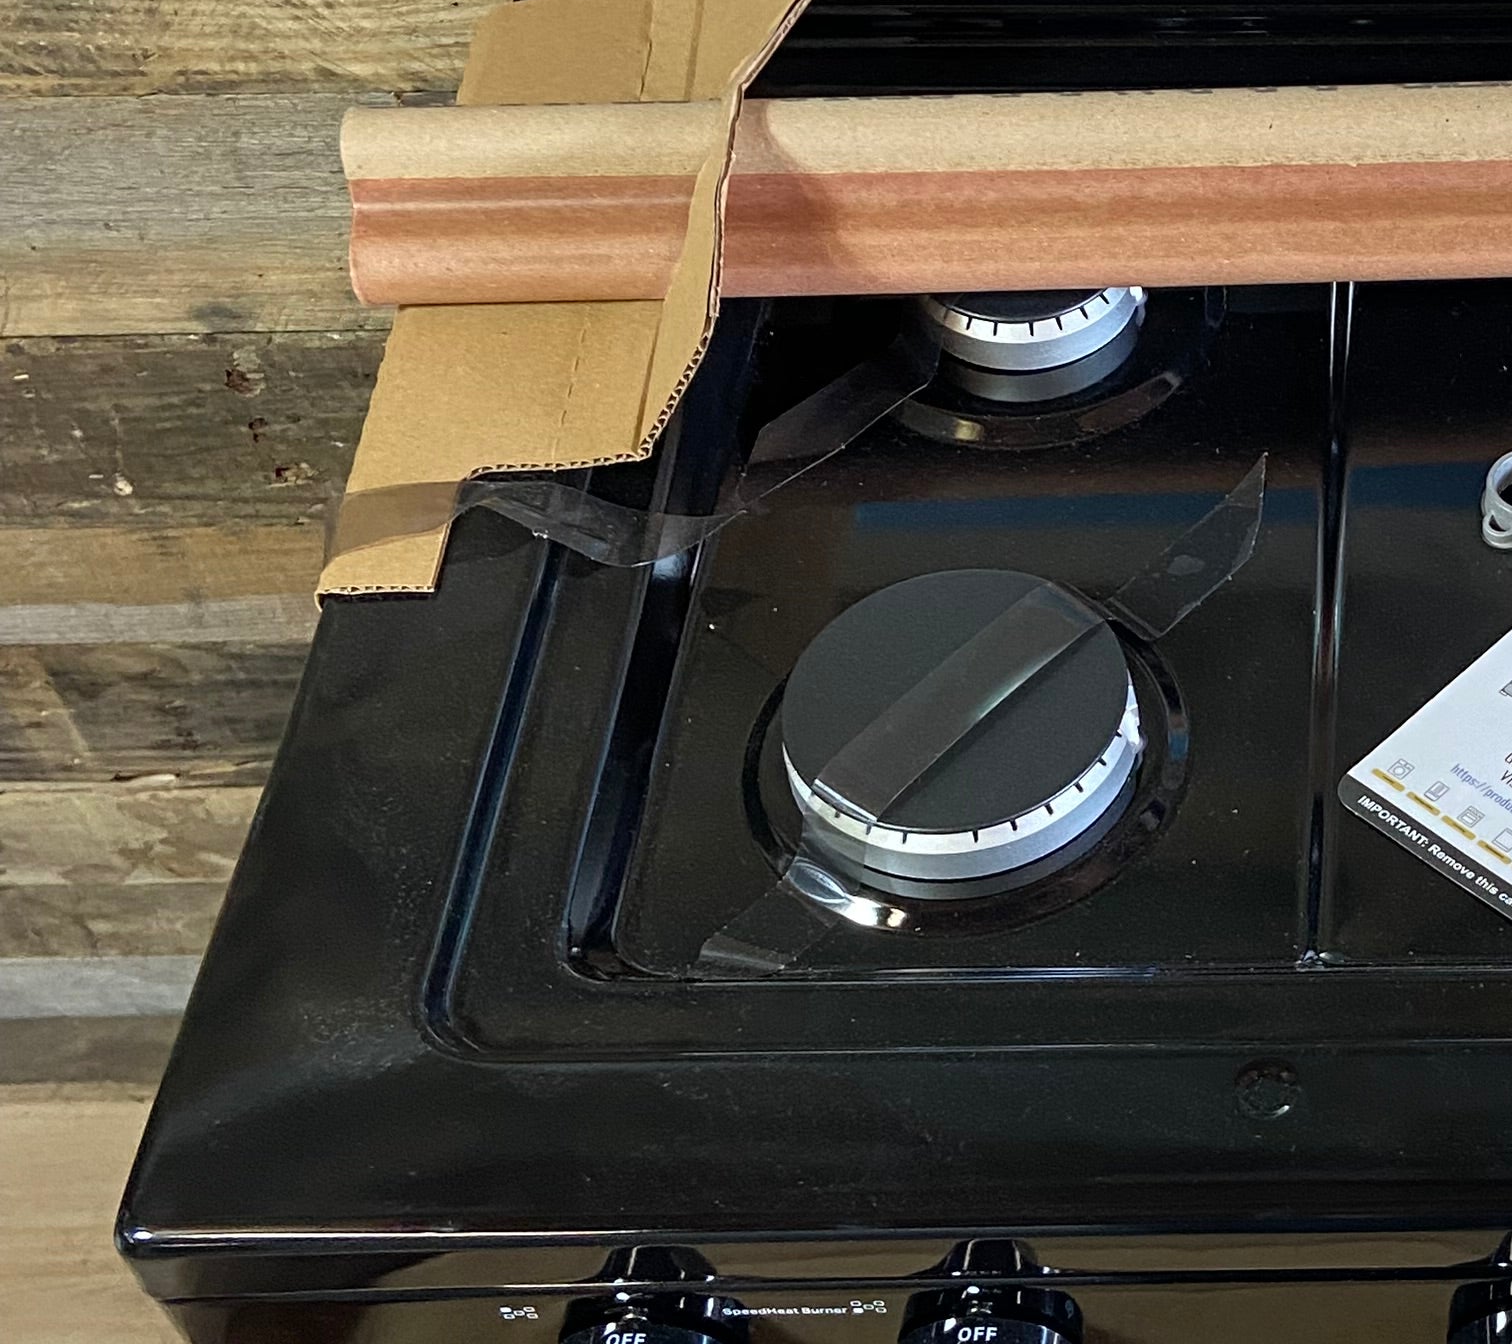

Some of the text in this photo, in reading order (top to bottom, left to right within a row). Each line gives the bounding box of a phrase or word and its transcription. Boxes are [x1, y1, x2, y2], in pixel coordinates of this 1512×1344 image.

[1357, 795, 1429, 848] IMPORTANT:
[1427, 843, 1476, 880] Remove
[1474, 875, 1499, 895] this
[802, 1307, 848, 1315] Burner
[957, 1326, 998, 1342] OFF
